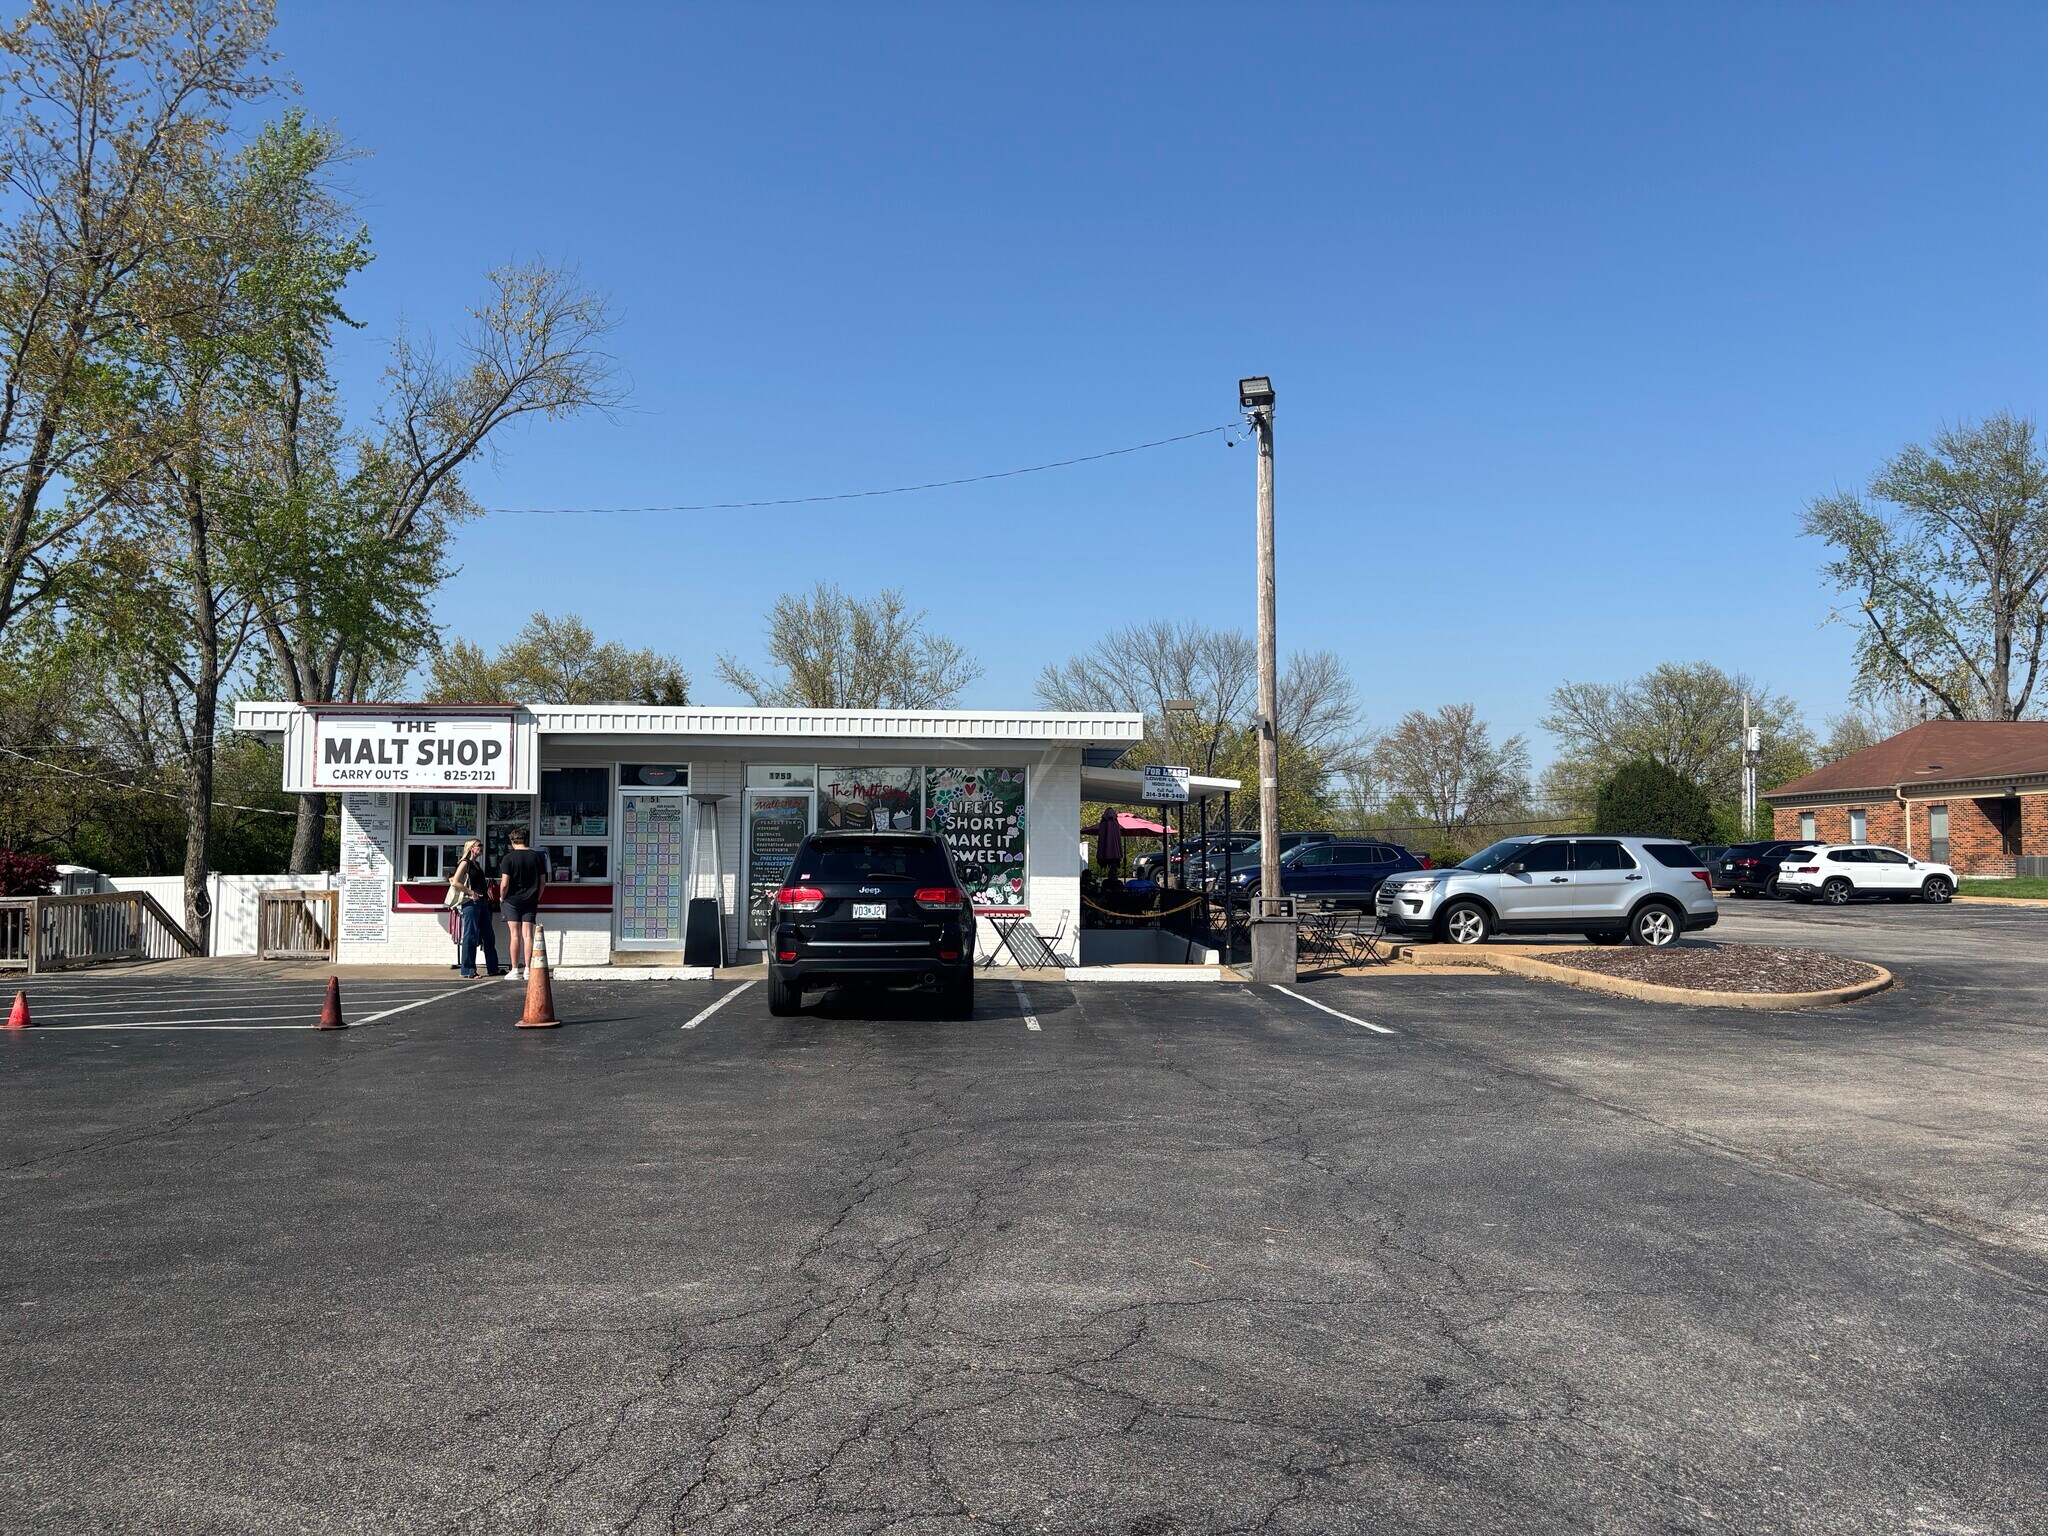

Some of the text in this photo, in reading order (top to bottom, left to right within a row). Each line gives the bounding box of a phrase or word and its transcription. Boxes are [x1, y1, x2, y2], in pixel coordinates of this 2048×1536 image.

[392, 721, 436, 733] THE
[324, 738, 502, 766] MALT SHOP
[332, 769, 372, 779] CARRY
[375, 770, 409, 780] OUTS
[769, 772, 792, 780] 1753
[889, 774, 903, 782] TO
[1146, 767, 1188, 778] FOR LEASE
[828, 783, 852, 799] The
[853, 783, 882, 800] Malt
[948, 800, 1004, 815] LIFE IS
[946, 816, 1006, 831] SHORT
[944, 833, 1013, 848] MAKE IT
[951, 849, 1007, 863] SWEET
[858, 886, 881, 895] Jeep
[871, 906, 886, 916] J2V
